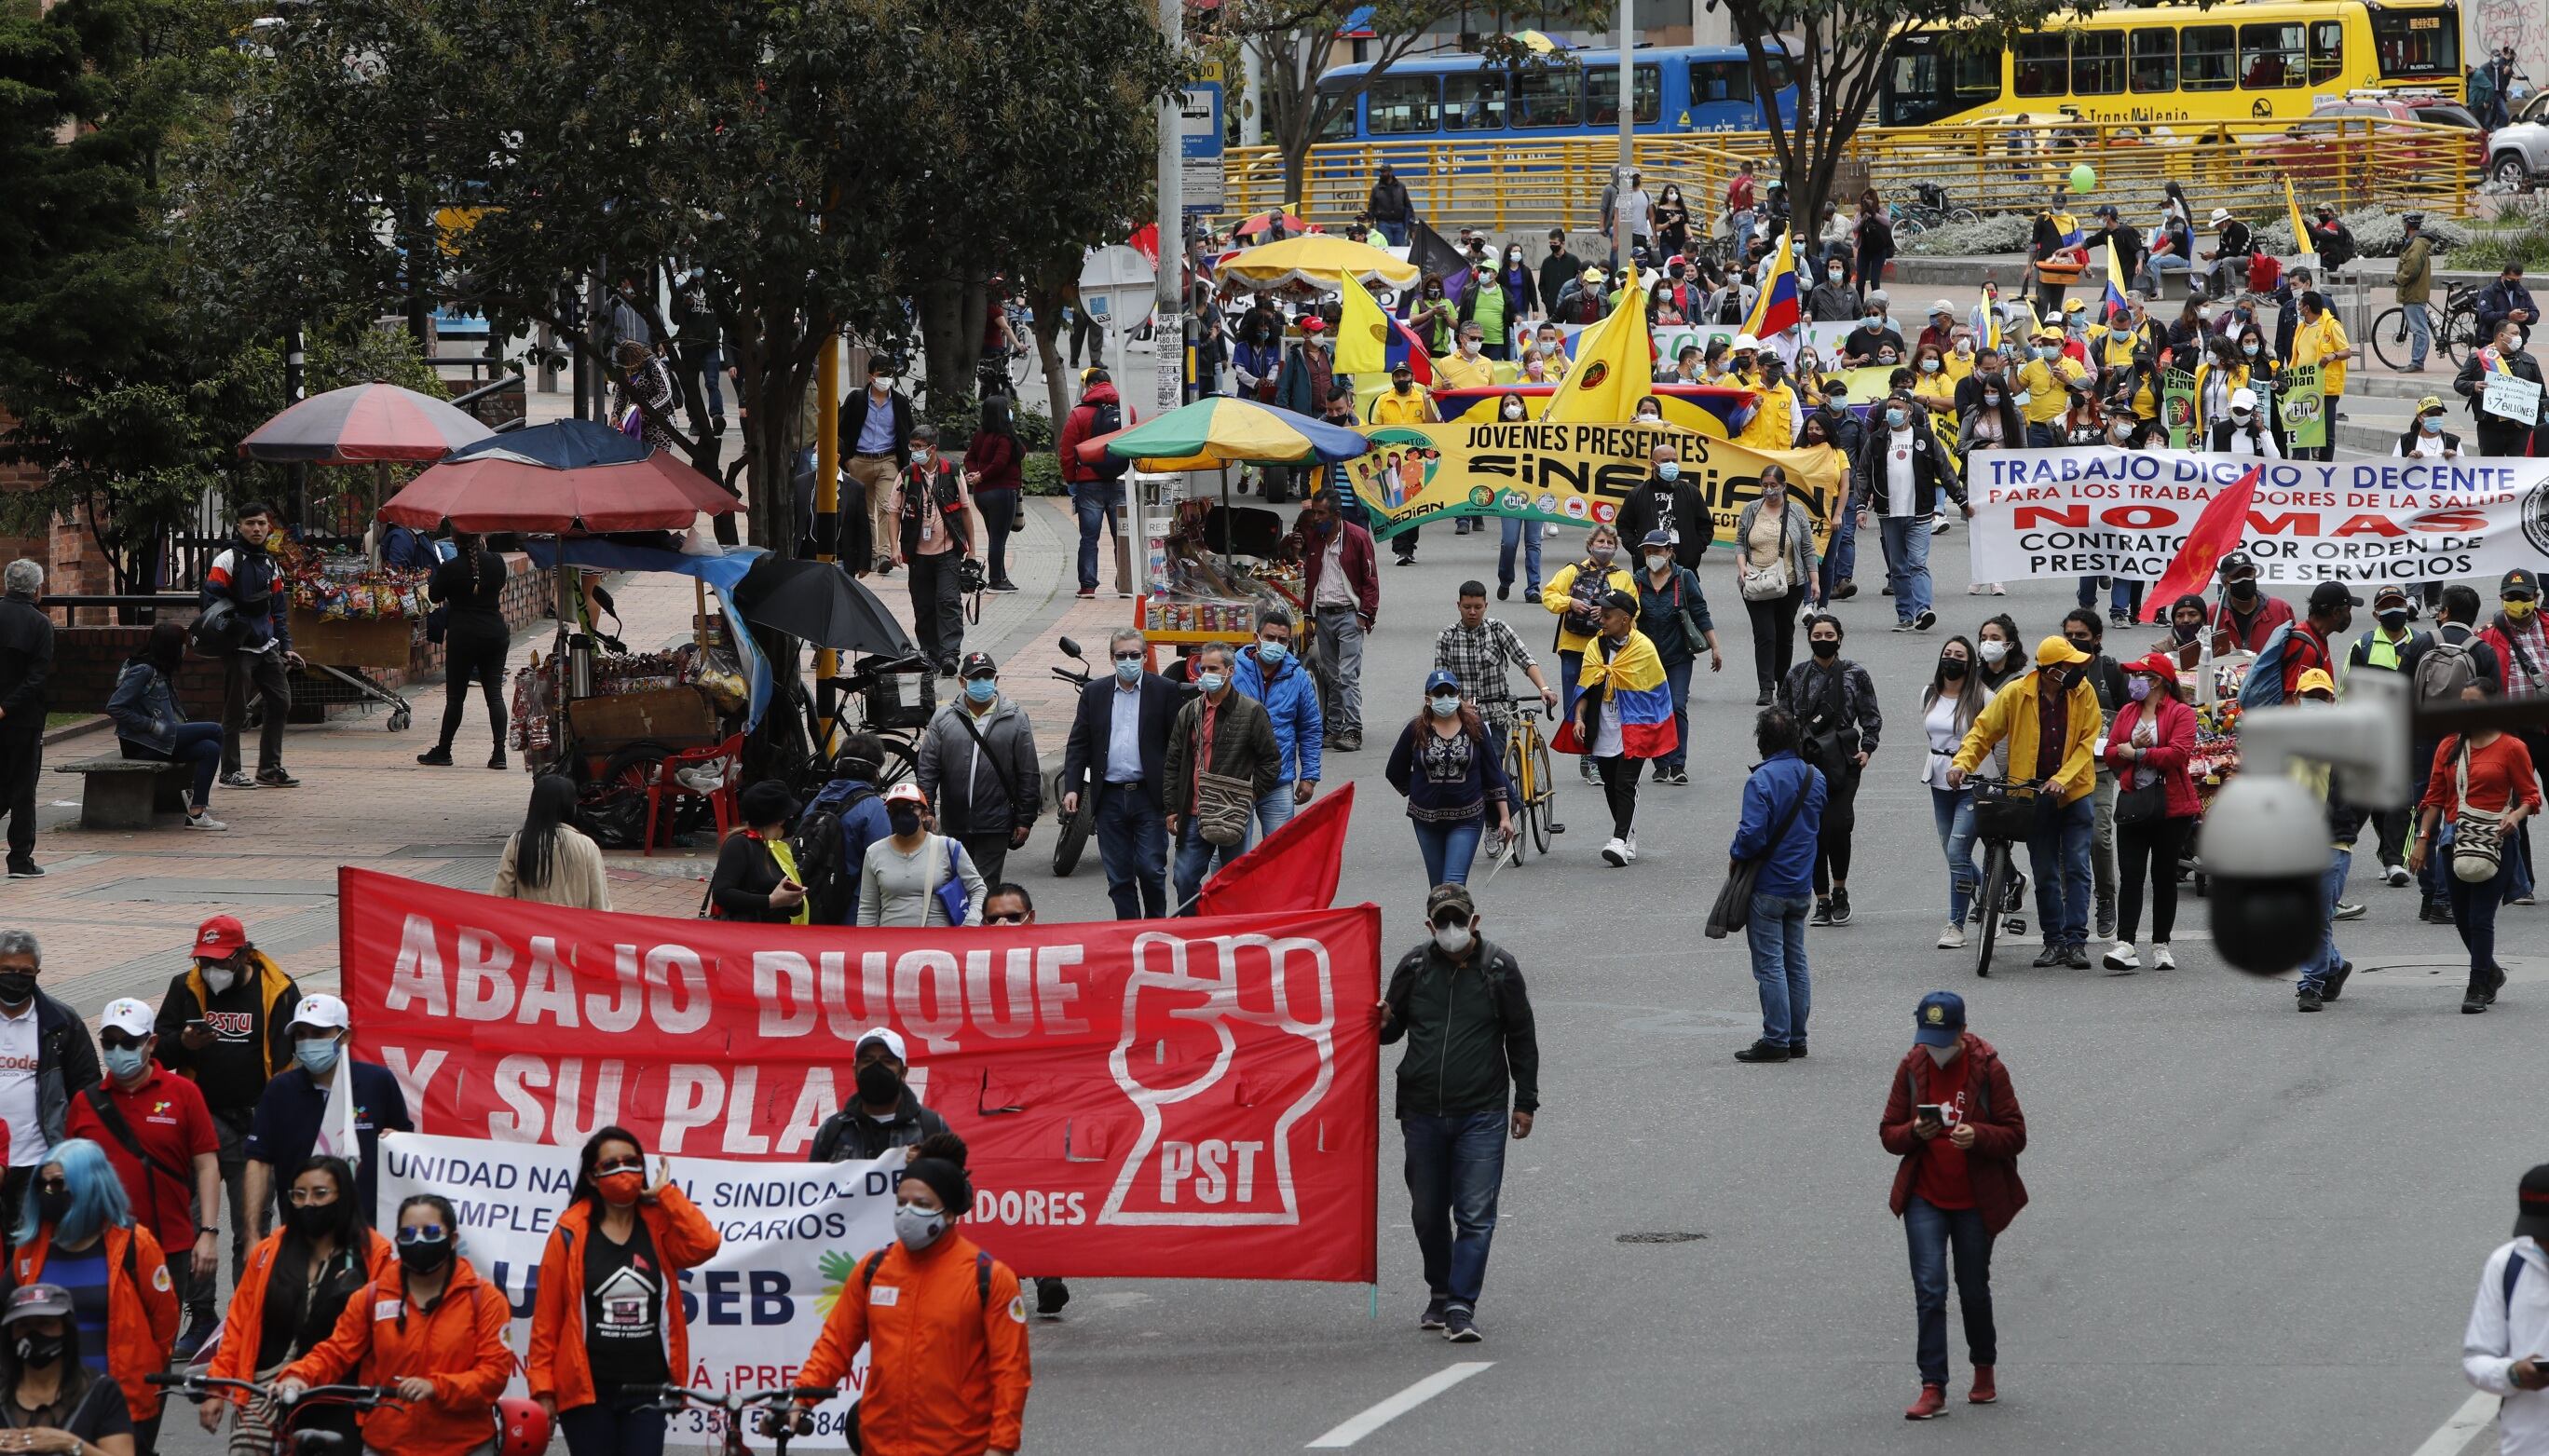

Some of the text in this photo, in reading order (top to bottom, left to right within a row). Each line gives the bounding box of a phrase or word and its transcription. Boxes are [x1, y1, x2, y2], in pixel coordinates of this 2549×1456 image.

[2089, 105, 2188, 122] TransMilenio
[2501, 401, 2536, 418] BILLONES
[1465, 424, 1711, 465] JÓVENES PRESENTES
[1990, 456, 2515, 492] TRABAJO DIGNO Y DECENTE
[1989, 483, 2516, 510] PARA LOS TRABADORES DE LA SALUD
[2013, 504, 2490, 538] NO MAS
[2311, 537, 2428, 560] ORDEN
[2443, 537, 2485, 552] DE
[2297, 554, 2473, 581] SERVICIOS
[385, 912, 1091, 1055] ABAJO DUQUE
[380, 1045, 929, 1154] Y SU PLA
[388, 1150, 518, 1191] UNIDAD
[713, 1180, 854, 1209] SINDICAL
[1159, 1138, 1264, 1205] PST
